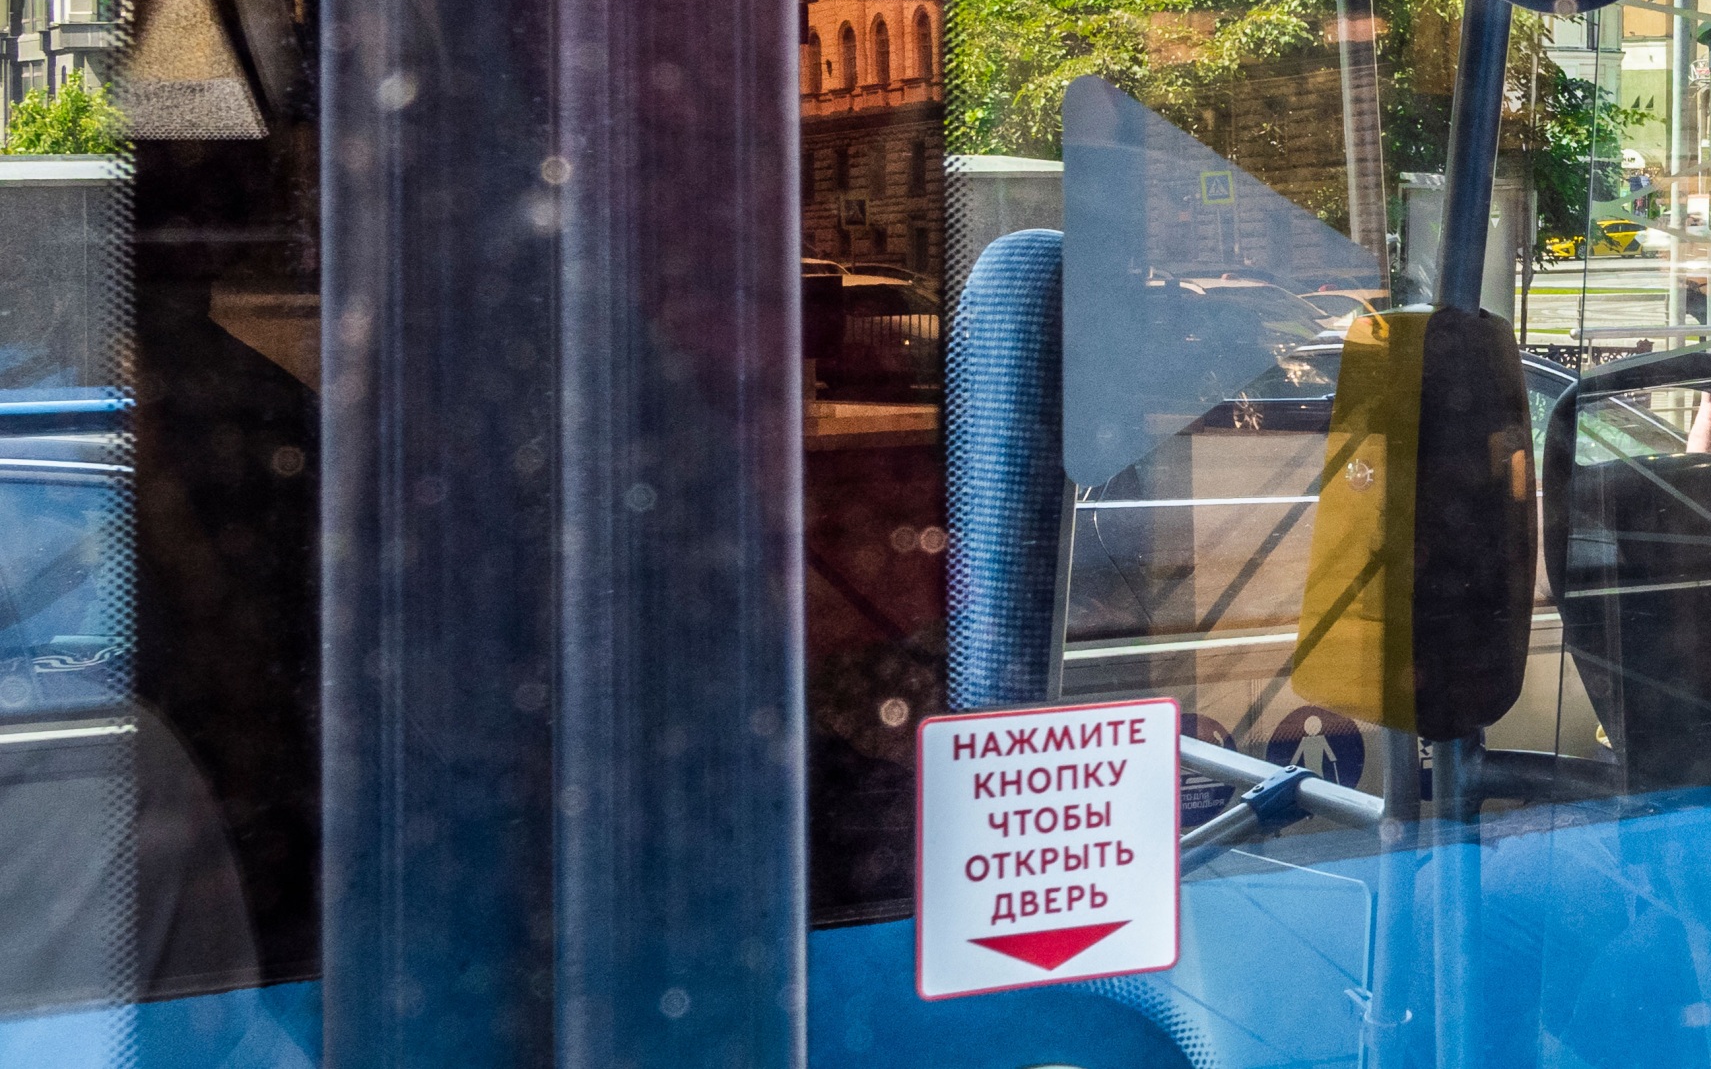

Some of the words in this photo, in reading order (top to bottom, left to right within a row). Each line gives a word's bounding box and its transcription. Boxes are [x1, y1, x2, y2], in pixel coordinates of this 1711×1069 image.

[952, 718, 1147, 761] НАЖМИТЕ
[973, 759, 1127, 800] КНОПКУ
[988, 801, 1111, 838] ЧТОБЫ
[964, 840, 1134, 882] ОТКРЫТЬ
[990, 883, 1108, 926] ДВЕРЬ
